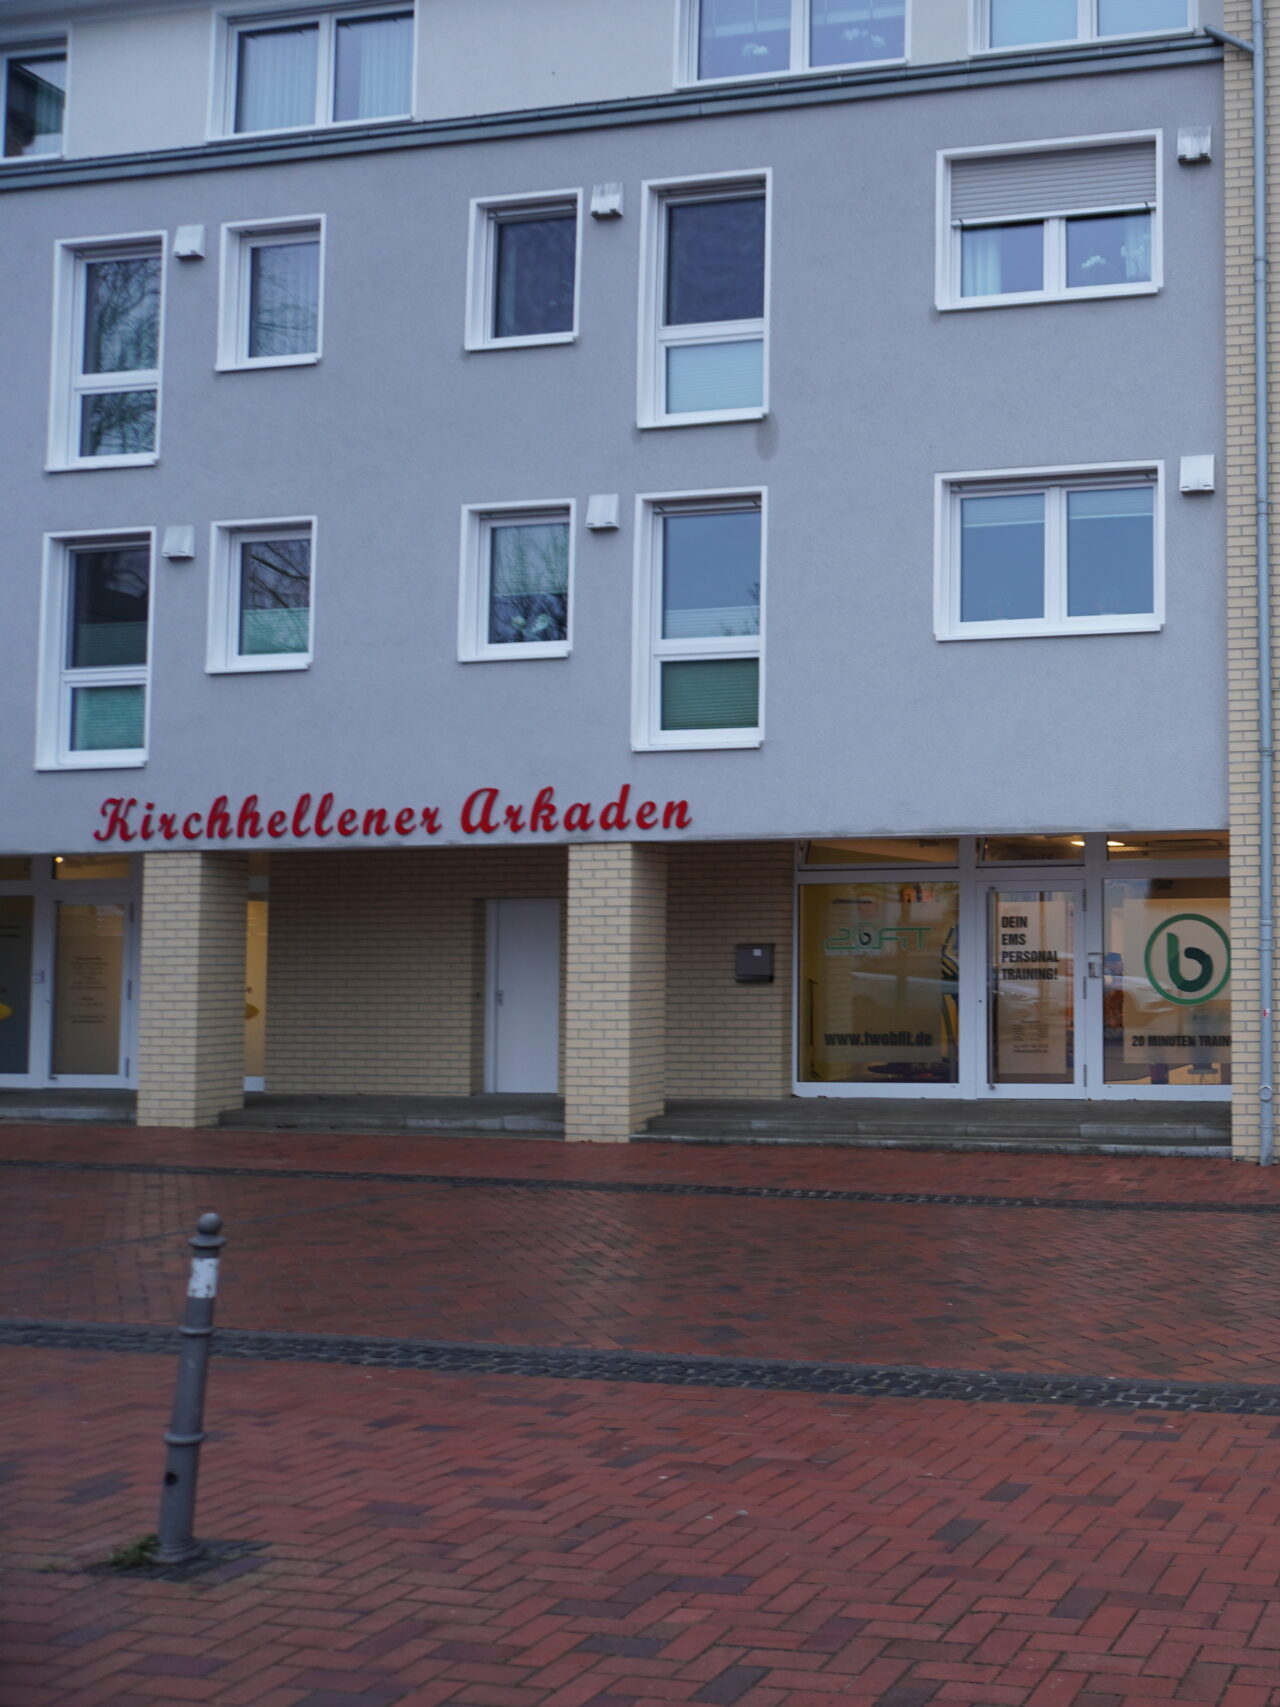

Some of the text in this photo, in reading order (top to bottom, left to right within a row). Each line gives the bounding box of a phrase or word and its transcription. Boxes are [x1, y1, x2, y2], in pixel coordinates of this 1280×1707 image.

[93, 783, 692, 841] Kirchhellener Arkaden
[1001, 916, 1028, 929] DEIN
[1001, 933, 1026, 946] EMS
[1001, 950, 1060, 963] PERSONAL
[1001, 968, 1058, 981] TRAINING!
[1131, 1035, 1145, 1047] 20
[1147, 1035, 1196, 1047] MINUTEN
